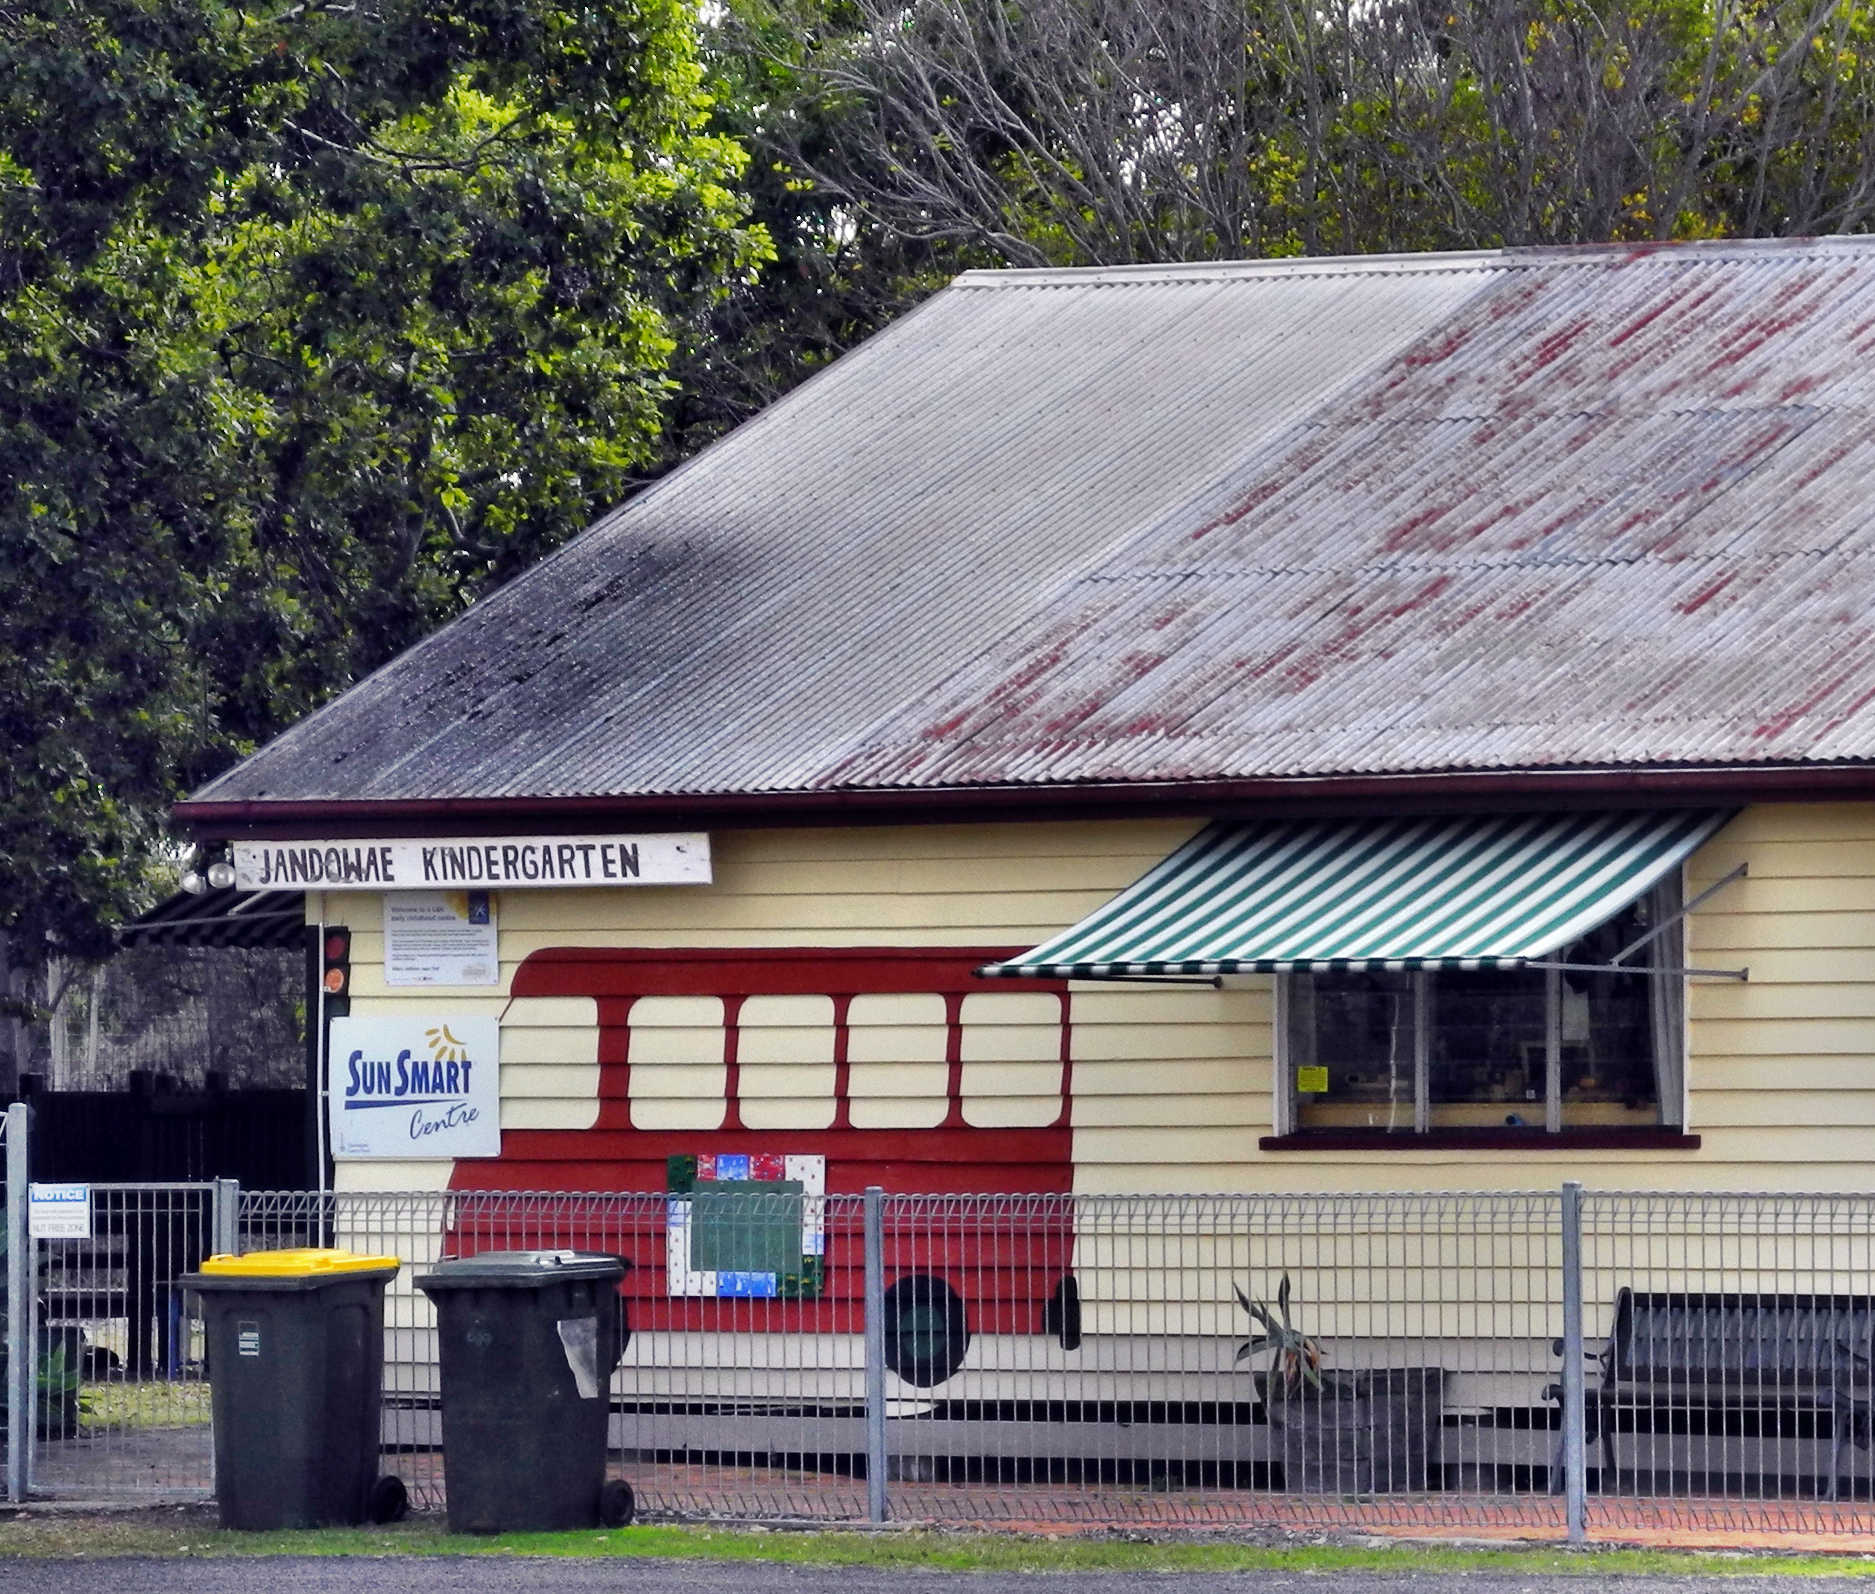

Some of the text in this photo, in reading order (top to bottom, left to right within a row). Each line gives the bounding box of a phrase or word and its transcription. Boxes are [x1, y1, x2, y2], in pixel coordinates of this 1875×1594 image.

[259, 843, 640, 884] JANDOWAE KINDERGARTEN
[409, 1103, 480, 1139] Centre
[33, 1190, 85, 1200] NOTICE
